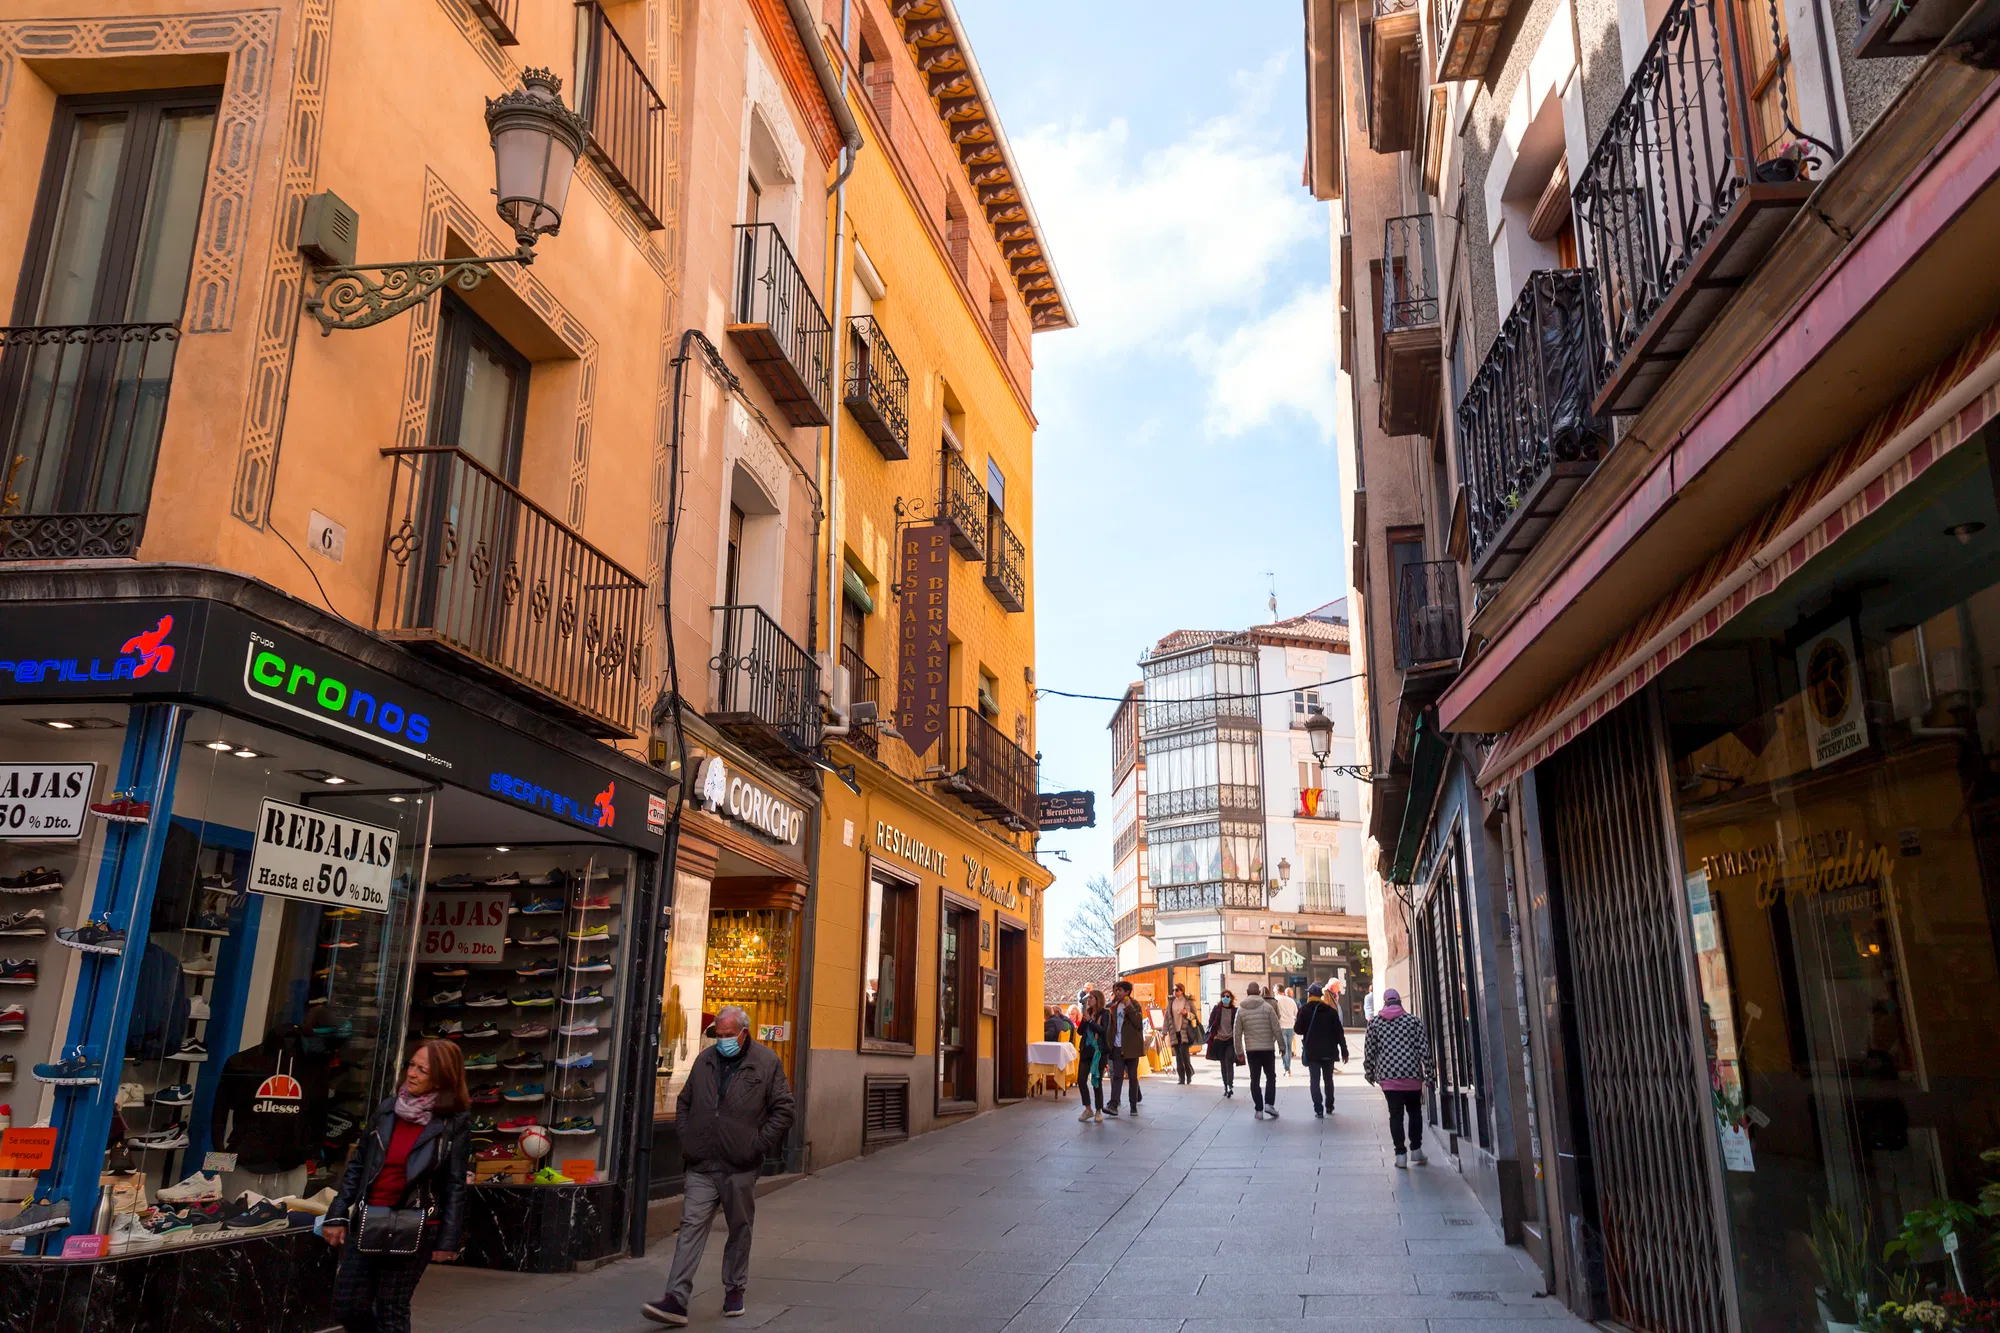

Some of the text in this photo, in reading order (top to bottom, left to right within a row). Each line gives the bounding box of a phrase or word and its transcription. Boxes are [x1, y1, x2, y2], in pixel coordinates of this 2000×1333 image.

[321, 527, 333, 550] 6
[250, 631, 275, 649] Grupo
[902, 541, 920, 728] RESTAURANTE
[924, 535, 944, 733] EL BERNARDINO
[253, 652, 431, 744] cronos
[1816, 732, 1862, 762] INTERFLORA
[44, 816, 72, 829] Dto.
[730, 777, 799, 846] CORKCHO
[1046, 807, 1085, 817] Bernardino
[262, 808, 393, 868] REBAJAS
[876, 820, 948, 878] RESTAURANTE
[258, 863, 384, 904] Hasta el 50 % Dto.
[426, 931, 455, 953] 50
[472, 942, 497, 954] Dto.
[1319, 946, 1338, 957] BAR
[253, 1100, 300, 1114] ellesse
[9, 1136, 50, 1146] Se necesita
[11, 1152, 43, 1161] personal
